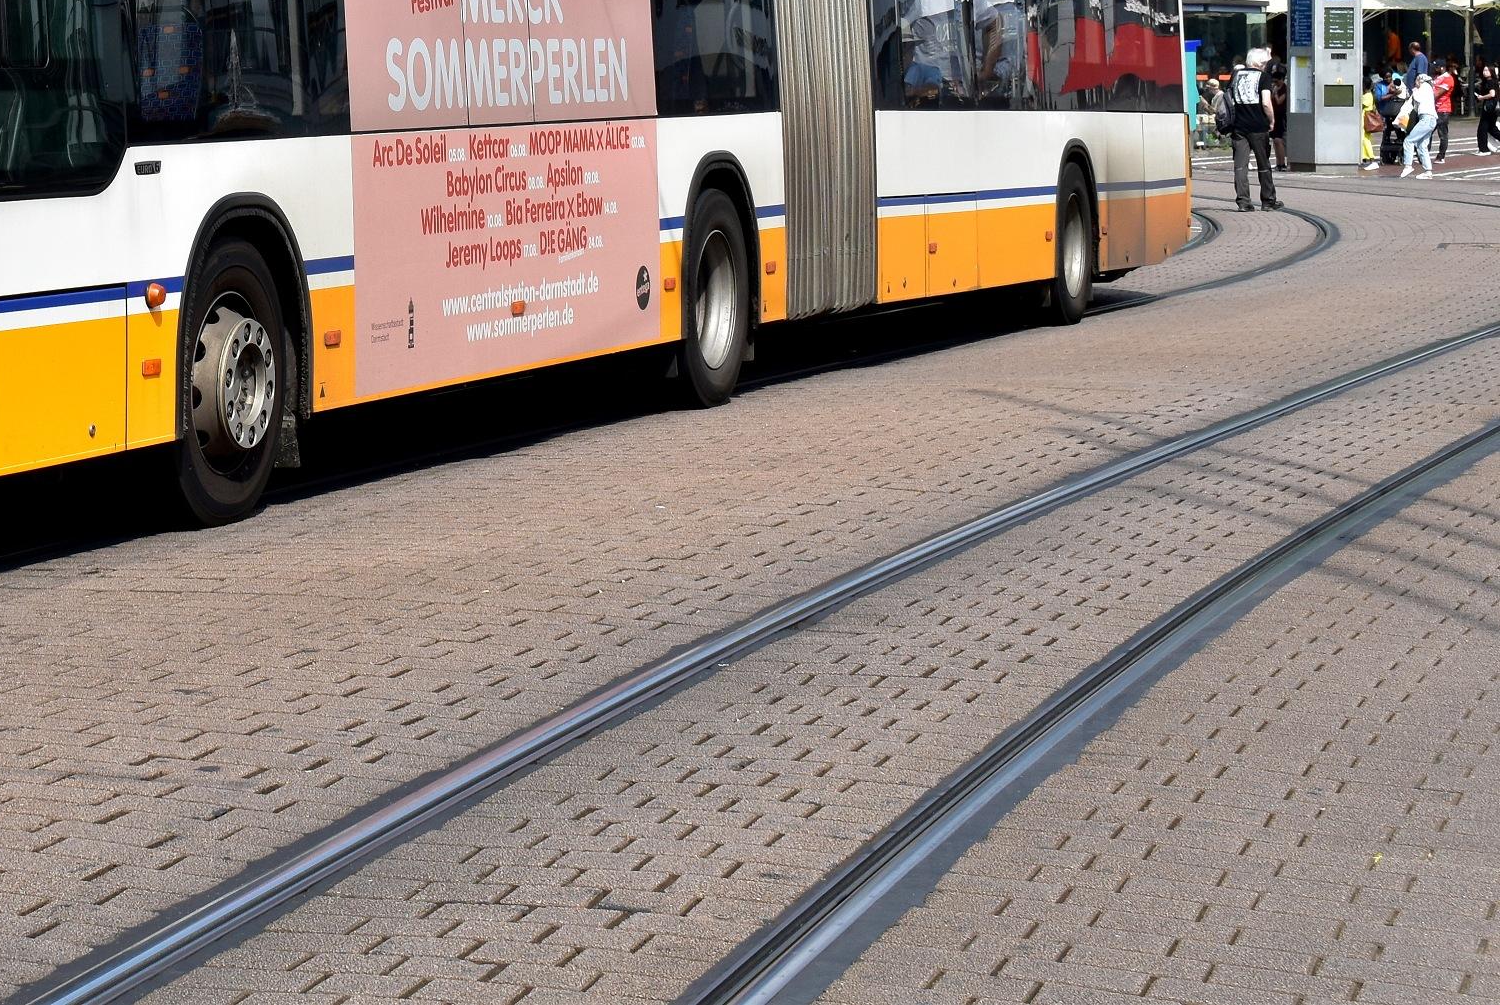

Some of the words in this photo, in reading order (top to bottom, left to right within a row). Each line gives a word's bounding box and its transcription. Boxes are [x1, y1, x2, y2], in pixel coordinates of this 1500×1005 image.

[386, 37, 628, 112] SOMMERPERLEN
[373, 139, 394, 168] Arc
[396, 138, 413, 166] De
[415, 134, 447, 165] Soleil
[469, 134, 510, 160] Kettcar
[529, 130, 562, 156] MOOP
[563, 128, 596, 153] MAMA
[605, 122, 630, 150] ÄLICE
[137, 164, 153, 174] EURO
[446, 167, 493, 203] Babylon
[494, 165, 527, 193] Circus
[547, 160, 583, 194] Apsilon
[420, 202, 486, 235] Wilhelmine
[505, 198, 524, 226] Bia
[525, 194, 565, 224] Ferreira
[576, 191, 603, 218] Ebow
[445, 241, 488, 270] Jeremy
[489, 236, 522, 267] Loops
[540, 230, 556, 255] D!E
[557, 221, 587, 253] GÄNG
[442, 270, 599, 317] www.centralstation-darmstadt.de
[466, 302, 574, 343] www.sommerperlen.de
